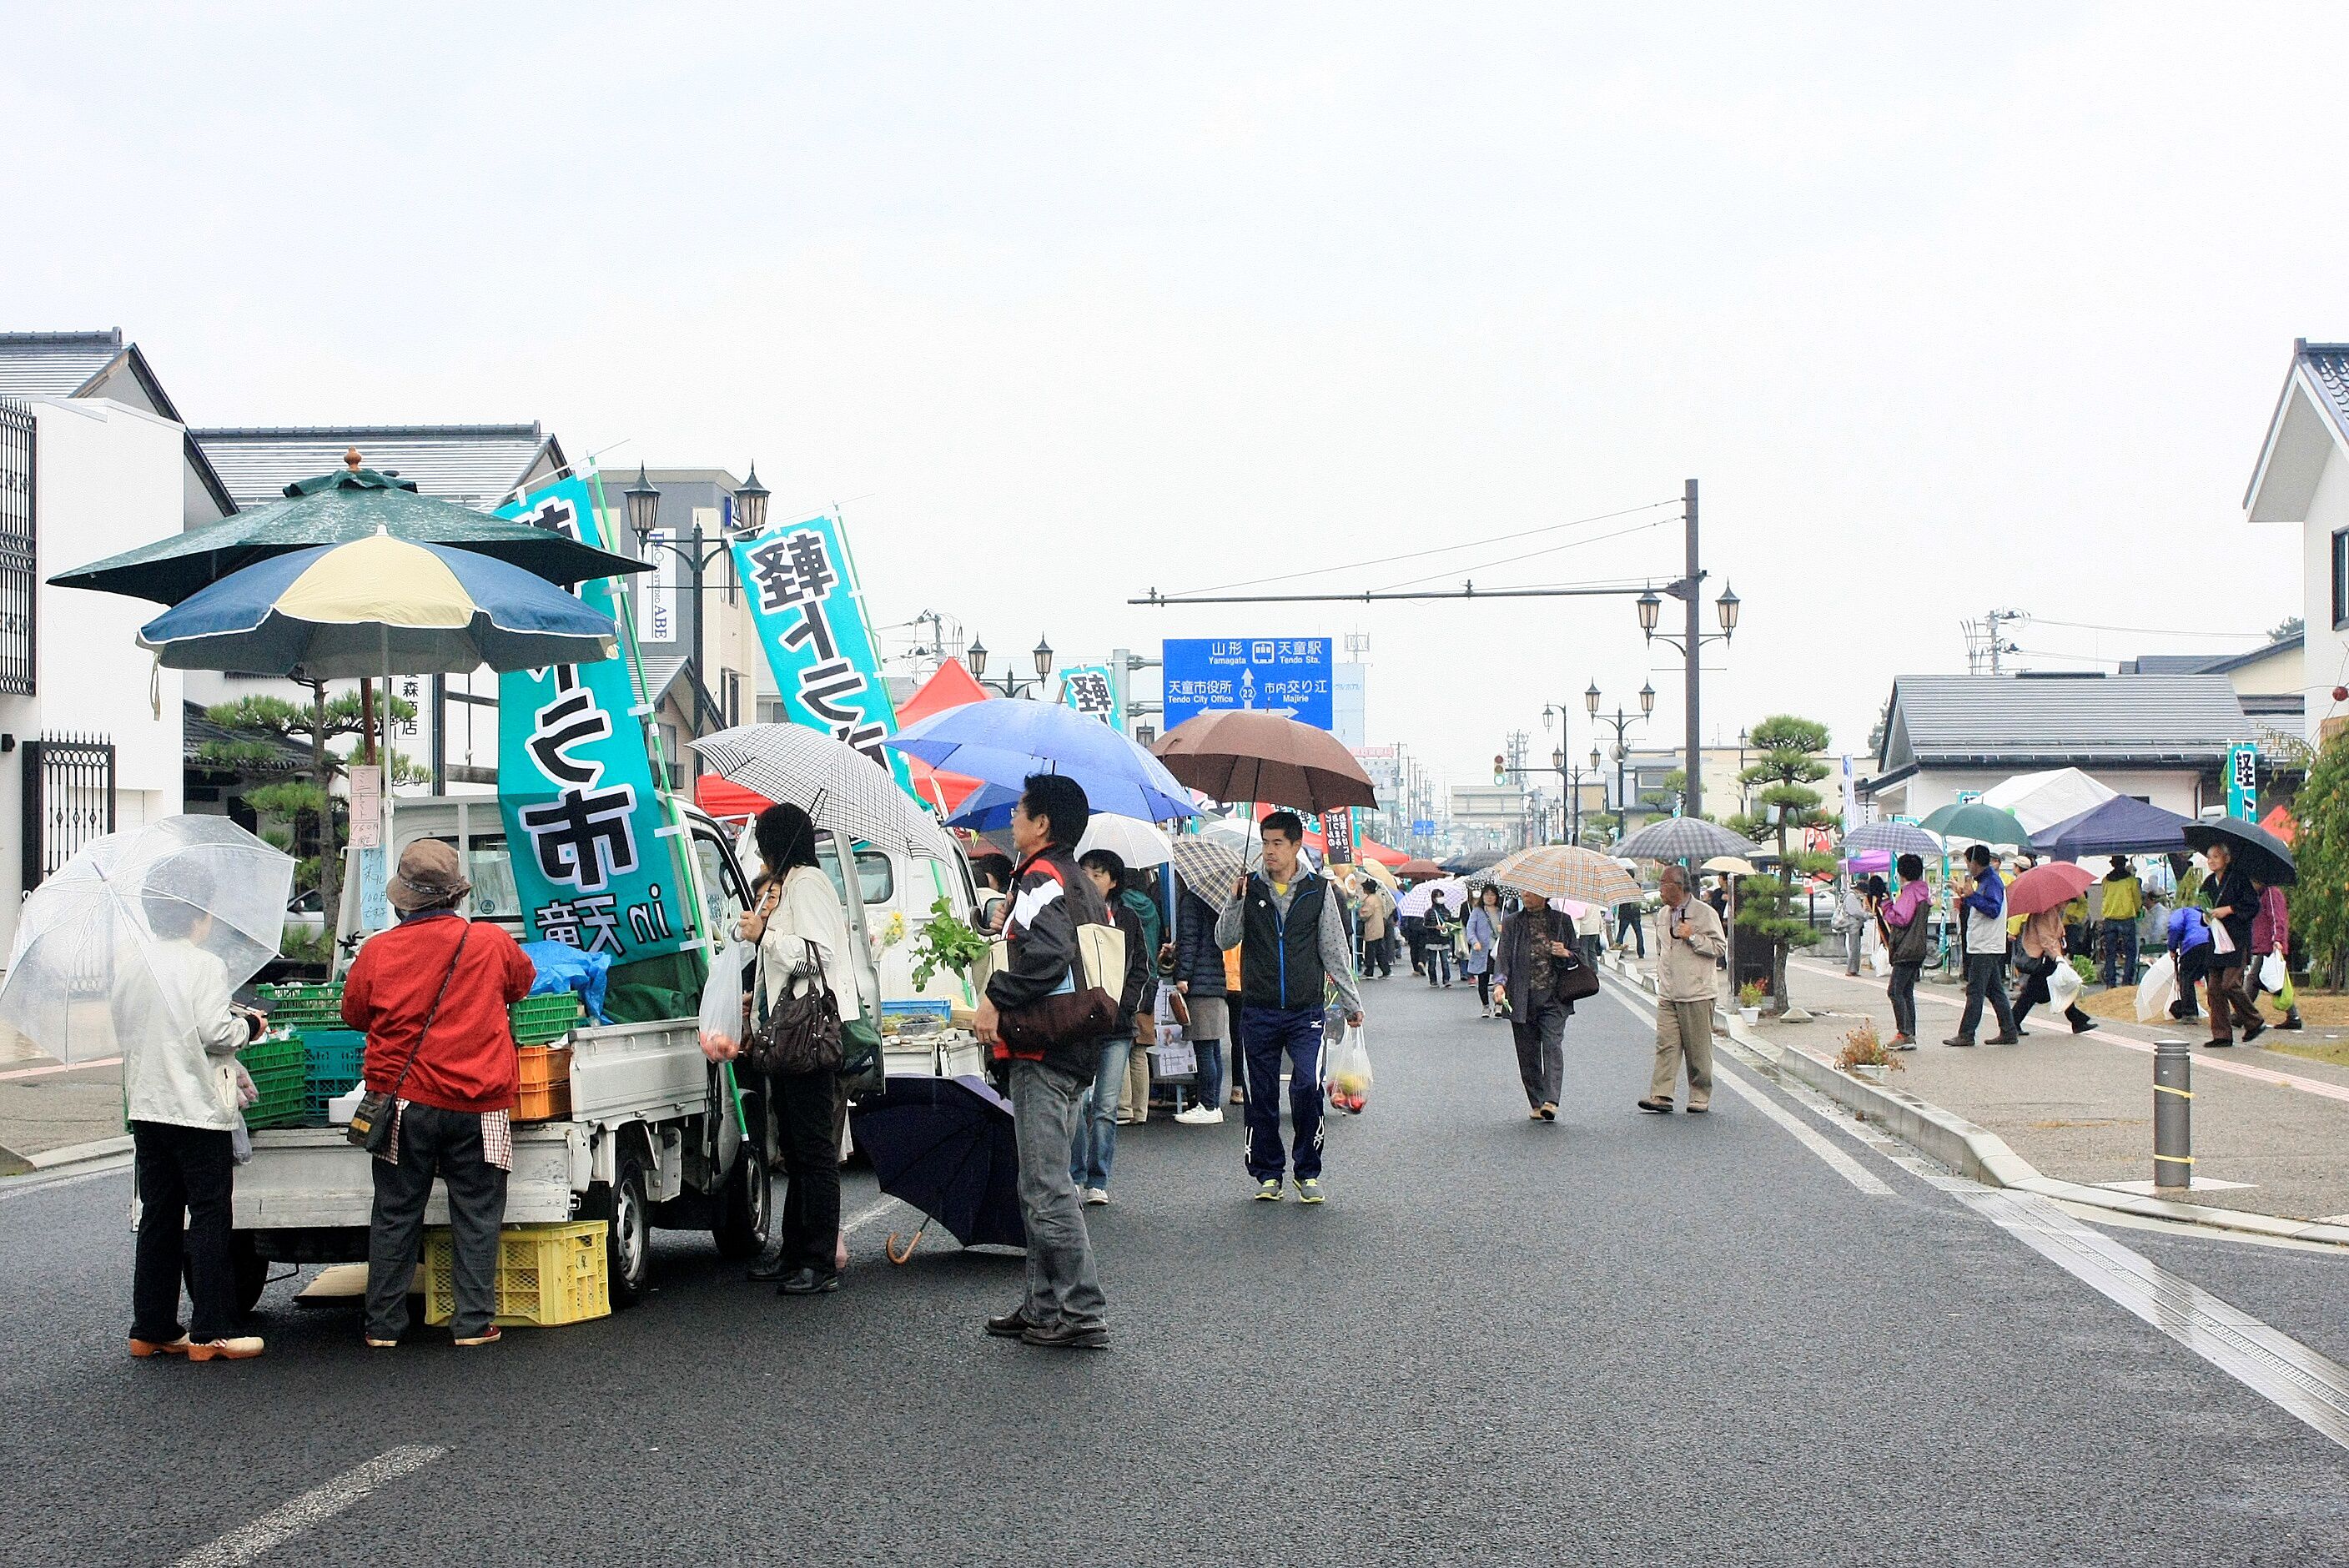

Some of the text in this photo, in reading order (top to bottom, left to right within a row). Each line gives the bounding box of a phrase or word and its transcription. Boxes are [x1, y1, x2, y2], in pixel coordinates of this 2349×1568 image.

[649, 532, 665, 573] PHOTO
[655, 605, 667, 639] ABE
[1212, 641, 1243, 656] 山形
[1277, 641, 1322, 656] 天童駅
[1209, 656, 1246, 666] Yamagata
[1169, 681, 1232, 695] 天童市役所
[1242, 688, 1254, 698] 22
[1265, 680, 1327, 694] 市内交り江
[403, 674, 419, 735] 森店
[1193, 696, 1209, 706] City
[1283, 695, 1309, 704] Majirie
